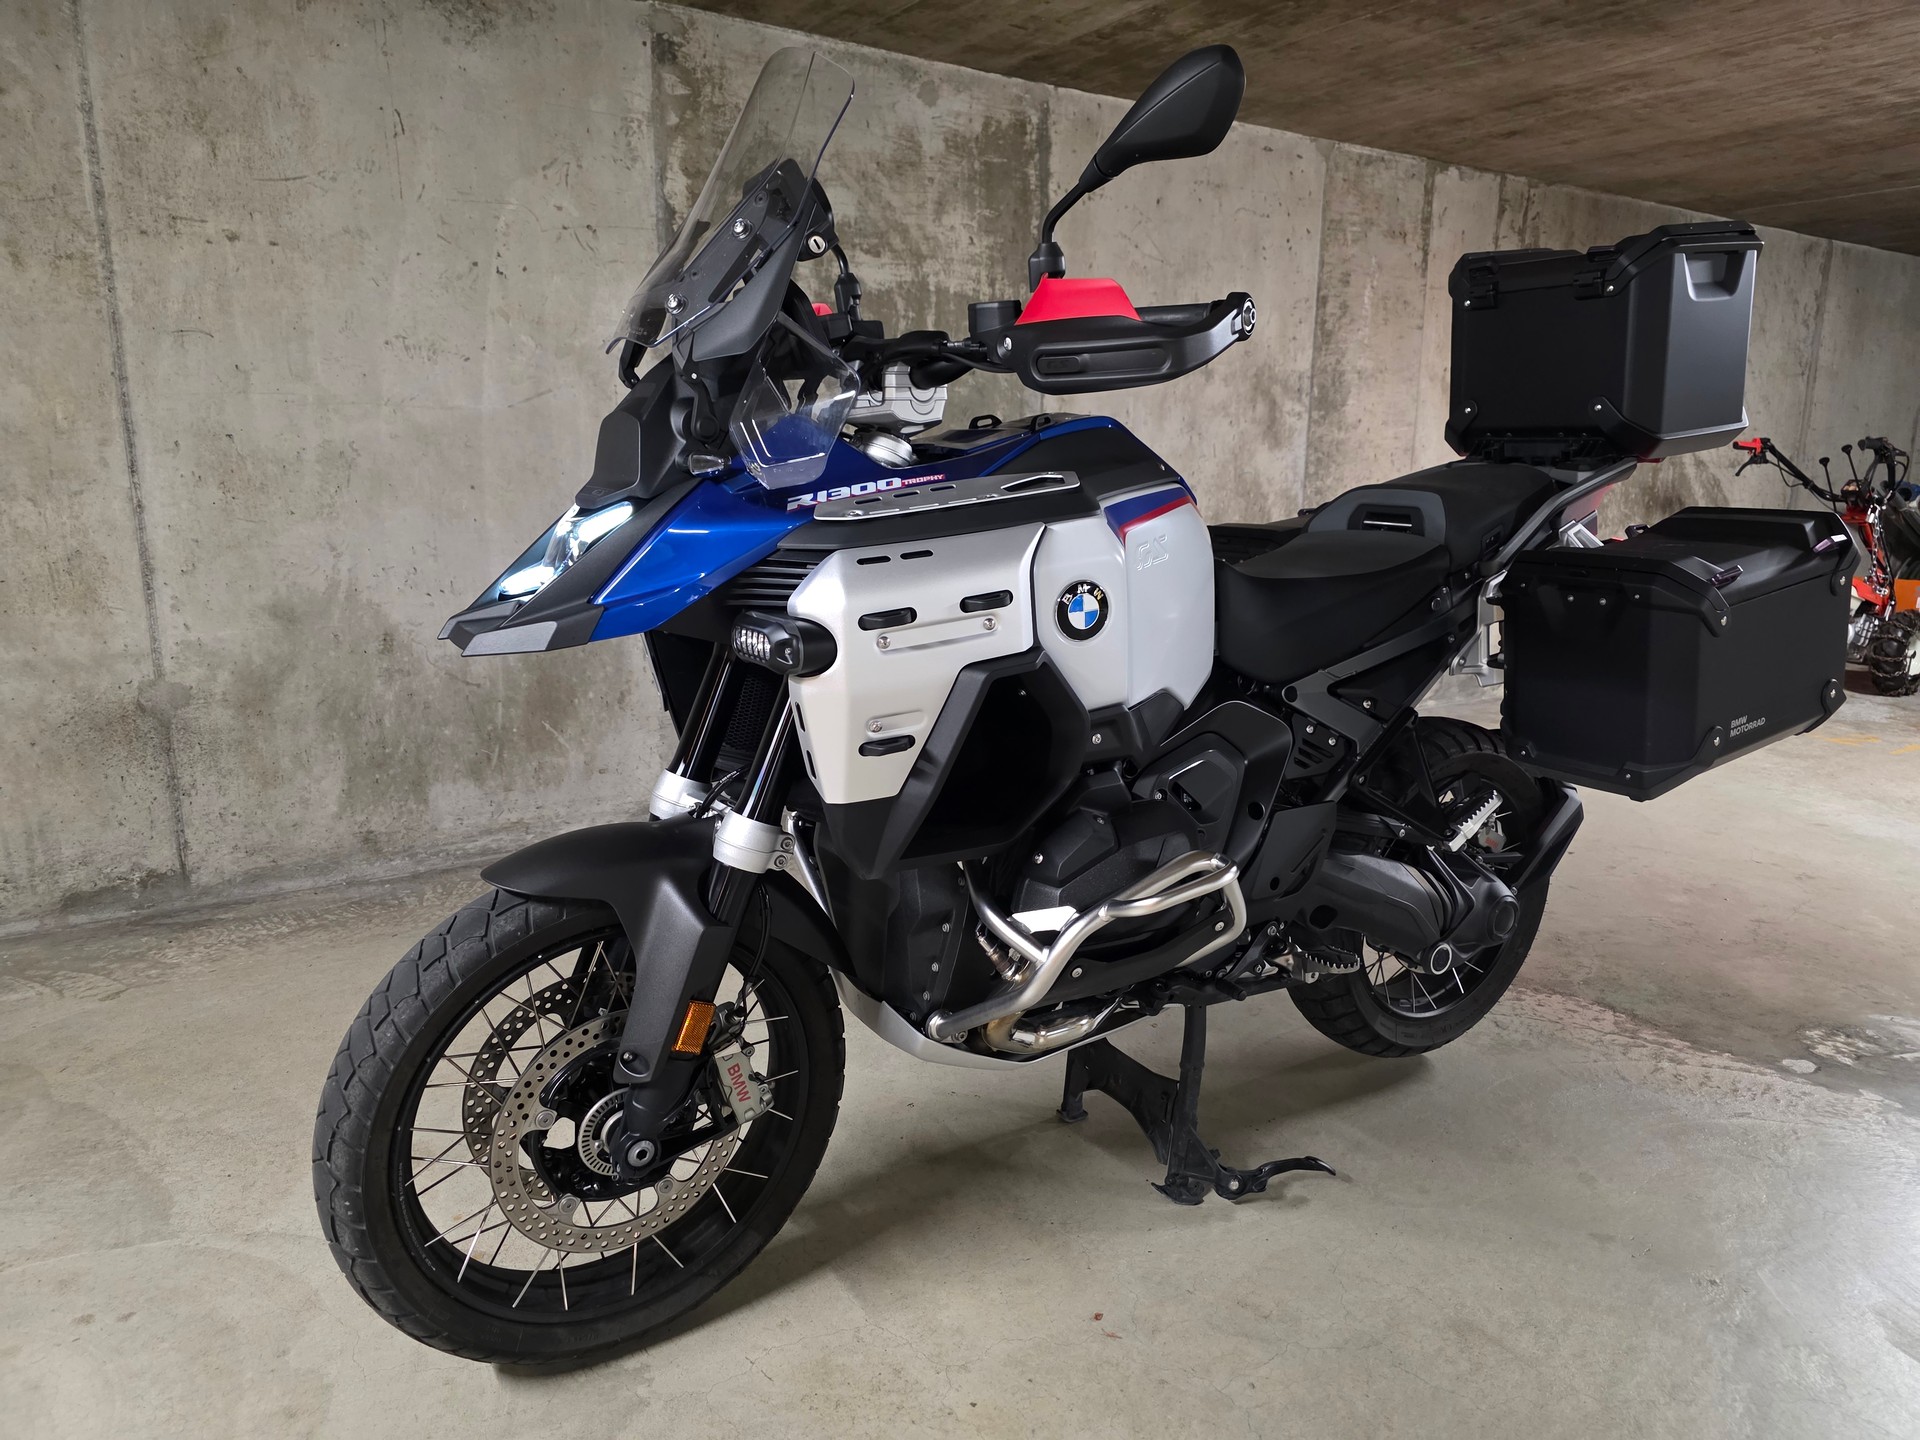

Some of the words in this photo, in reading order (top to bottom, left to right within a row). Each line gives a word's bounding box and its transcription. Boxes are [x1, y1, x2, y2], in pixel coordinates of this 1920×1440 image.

[903, 474, 943, 484] TROPHY
[1062, 584, 1104, 604] BMW
[1729, 717, 1766, 738] MOTORRAD
[1730, 714, 1748, 728] BMW
[727, 1063, 752, 1103] BMW
